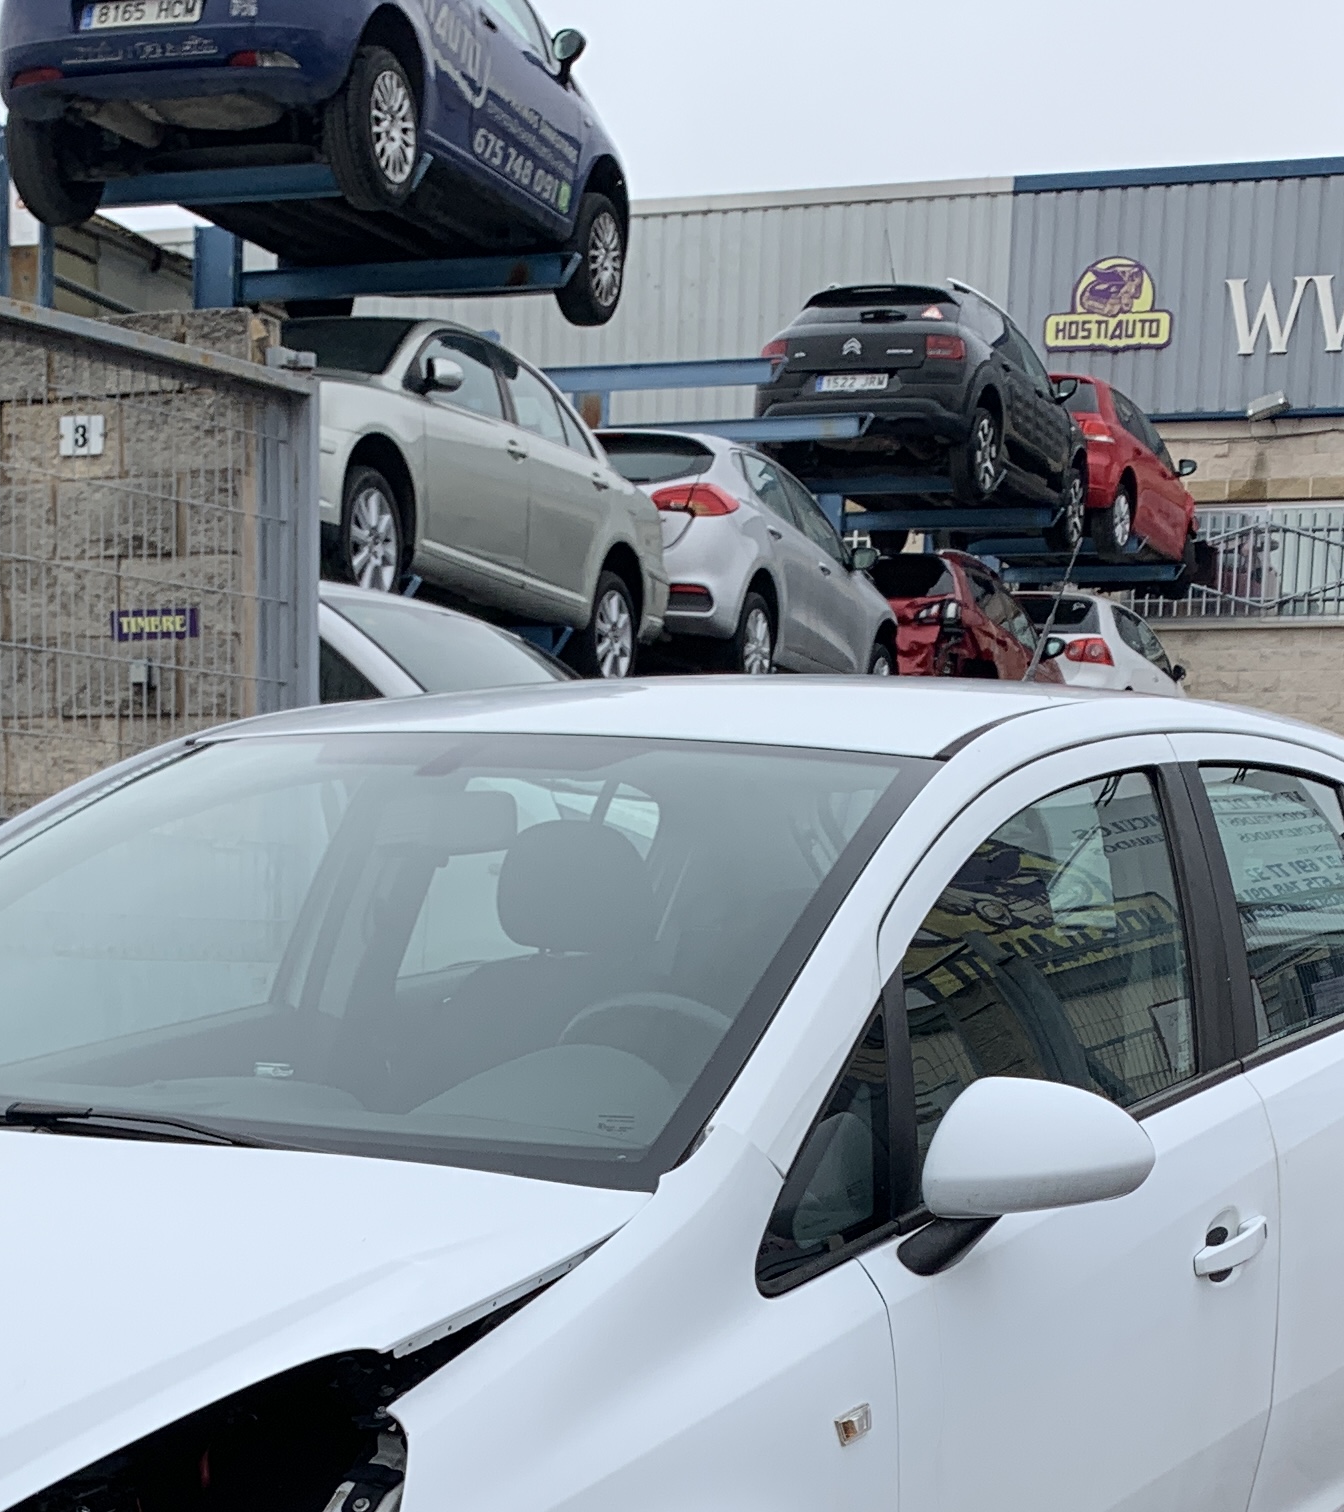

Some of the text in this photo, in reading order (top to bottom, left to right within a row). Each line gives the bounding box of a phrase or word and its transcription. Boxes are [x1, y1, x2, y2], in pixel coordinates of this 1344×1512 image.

[96, 2, 146, 24] 8165
[473, 127, 506, 166] 675
[504, 146, 535, 185] 748
[1054, 318, 1161, 341] HOSTIAUTO
[825, 377, 857, 390] 1522
[74, 424, 88, 448] 3
[119, 614, 186, 634] TIMBRE
